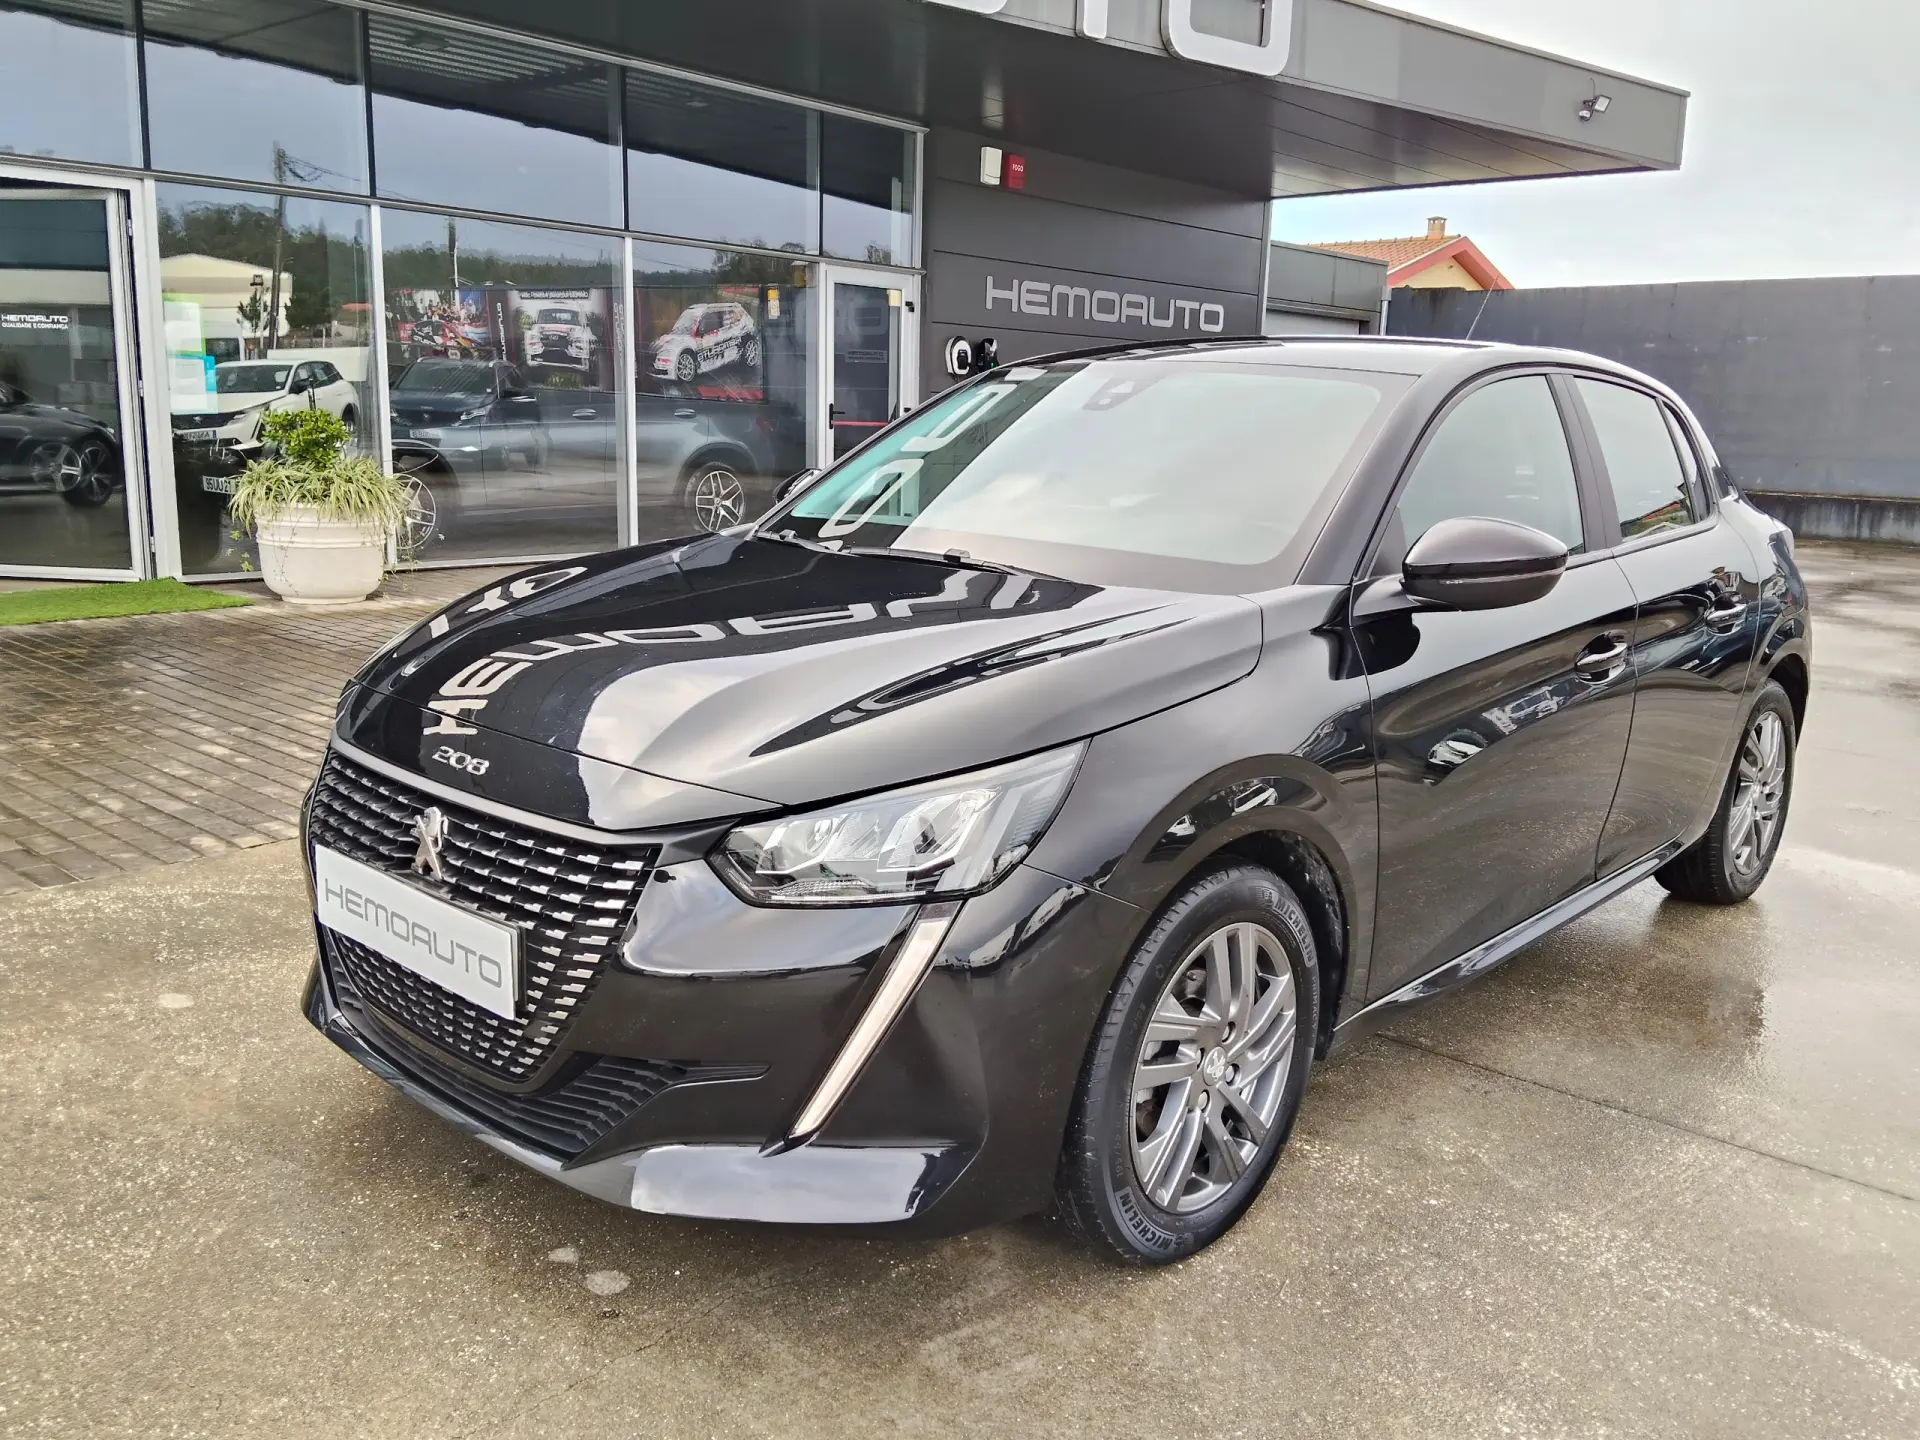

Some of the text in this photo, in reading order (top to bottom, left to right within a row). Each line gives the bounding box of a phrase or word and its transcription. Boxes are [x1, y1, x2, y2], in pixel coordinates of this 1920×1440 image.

[1012, 163, 1024, 172] FOGO
[1, 314, 69, 323] HEMOAUTO
[37, 323, 69, 331] CONFIANÇA
[985, 275, 1225, 334] HEMOAUTO
[431, 745, 490, 776] 208
[324, 877, 503, 990] HEMOAUTO
[1273, 897, 1317, 964] MICHELIN
[1119, 1191, 1174, 1251] MICHELIN
